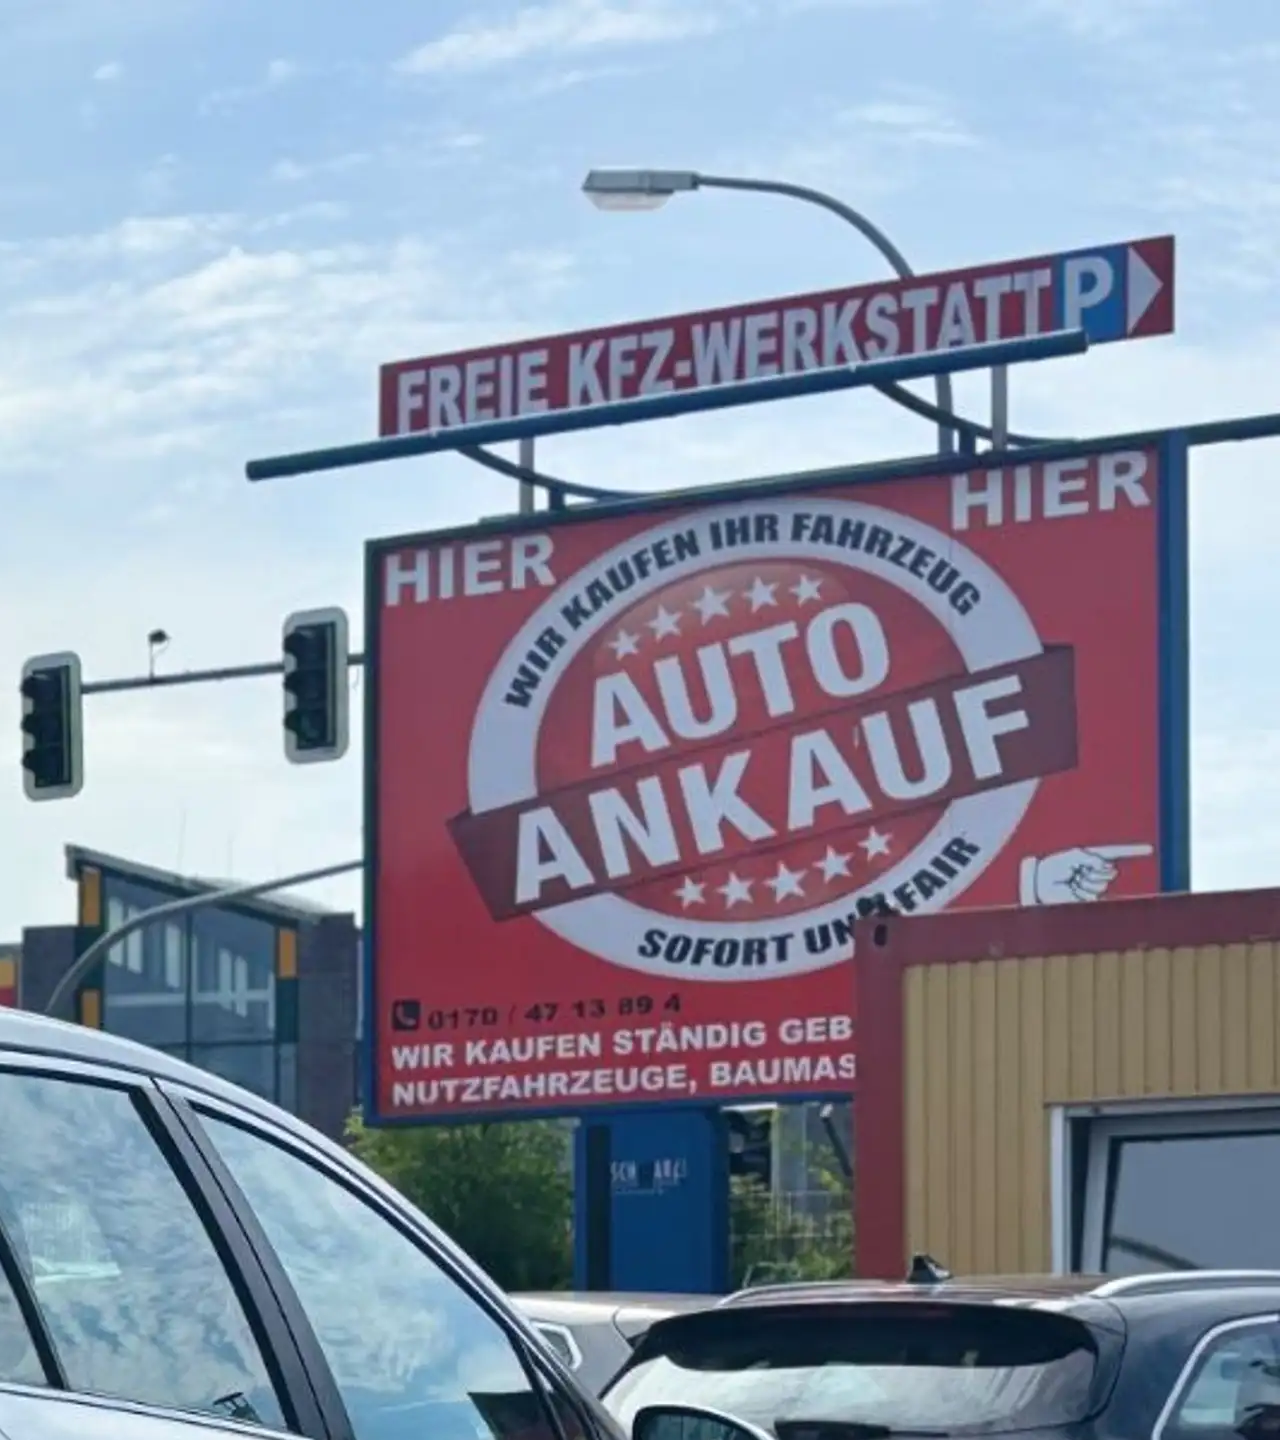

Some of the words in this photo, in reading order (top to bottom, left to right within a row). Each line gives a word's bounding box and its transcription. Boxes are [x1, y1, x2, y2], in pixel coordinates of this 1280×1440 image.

[397, 350, 548, 436] FREIE
[568, 268, 1052, 408] KFZ-WERKSTATT
[1063, 255, 1115, 331] P
[950, 450, 1152, 532] HIER
[383, 532, 557, 607] HIER
[504, 625, 567, 709] WIR
[559, 528, 702, 632] KAUFEN
[709, 512, 780, 552] IHR
[790, 512, 982, 617] FAHRZEUG
[590, 602, 890, 769] AUTO
[513, 674, 1030, 905] ANKAUF
[637, 927, 796, 968] SOFORT
[803, 905, 872, 954] UN
[892, 836, 982, 914] FAIR
[391, 1044, 454, 1070] WIR
[465, 1032, 602, 1065] KAUFEN
[612, 1020, 768, 1056] STÄNDIG
[779, 1014, 854, 1046] GEB
[427, 1006, 499, 1031] 0170
[524, 1002, 560, 1023] 47
[574, 998, 607, 1020] 13
[664, 992, 682, 1014] 4
[392, 1063, 697, 1107] NUTZFAHRZEUGE,
[709, 1052, 856, 1088] BAUMAS
